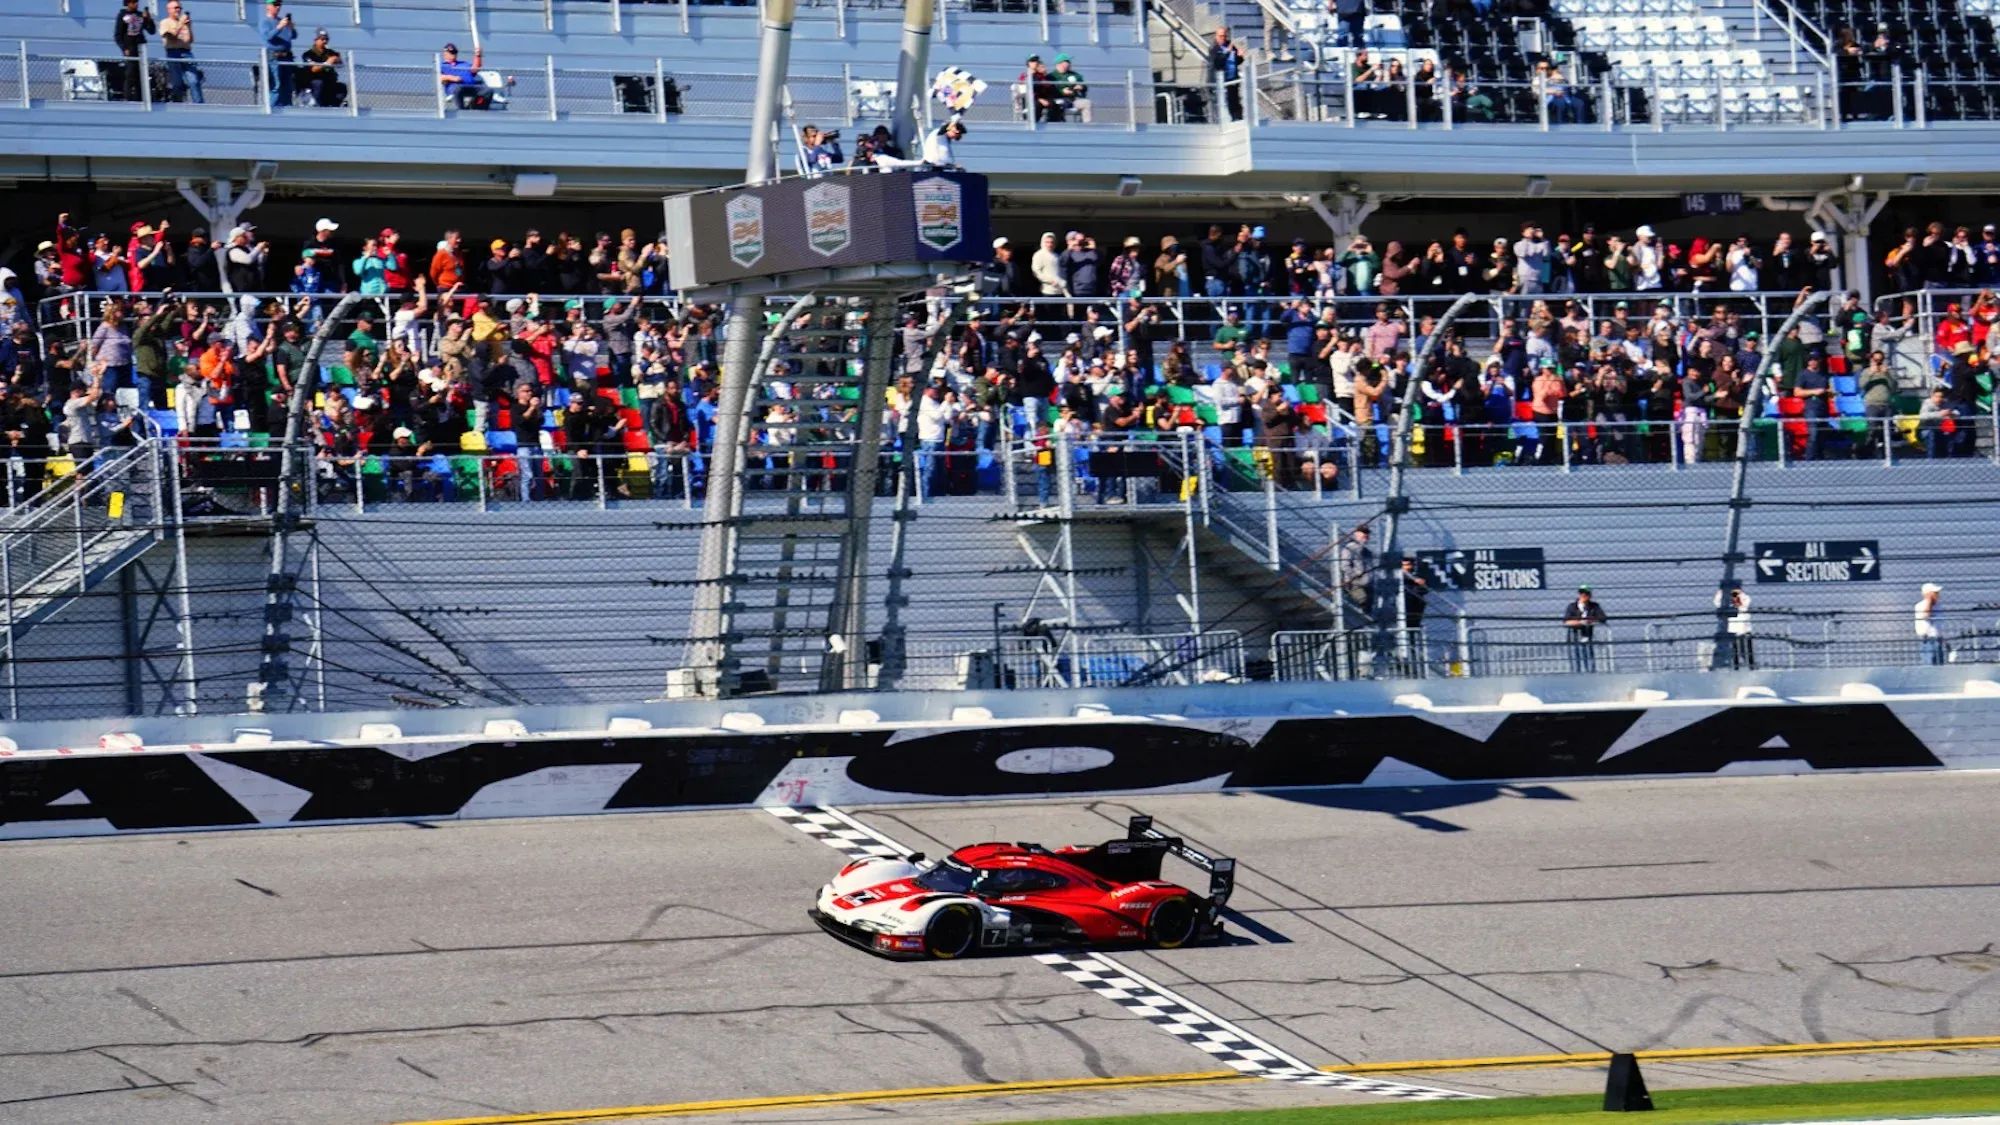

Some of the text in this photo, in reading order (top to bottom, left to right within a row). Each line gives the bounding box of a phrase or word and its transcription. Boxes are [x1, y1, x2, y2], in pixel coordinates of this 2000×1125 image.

[1685, 193, 1741, 212] 145 144
[1474, 568, 1540, 589] SECTIONS
[1785, 560, 1851, 582] SECTIONS
[991, 930, 1000, 943] 7
